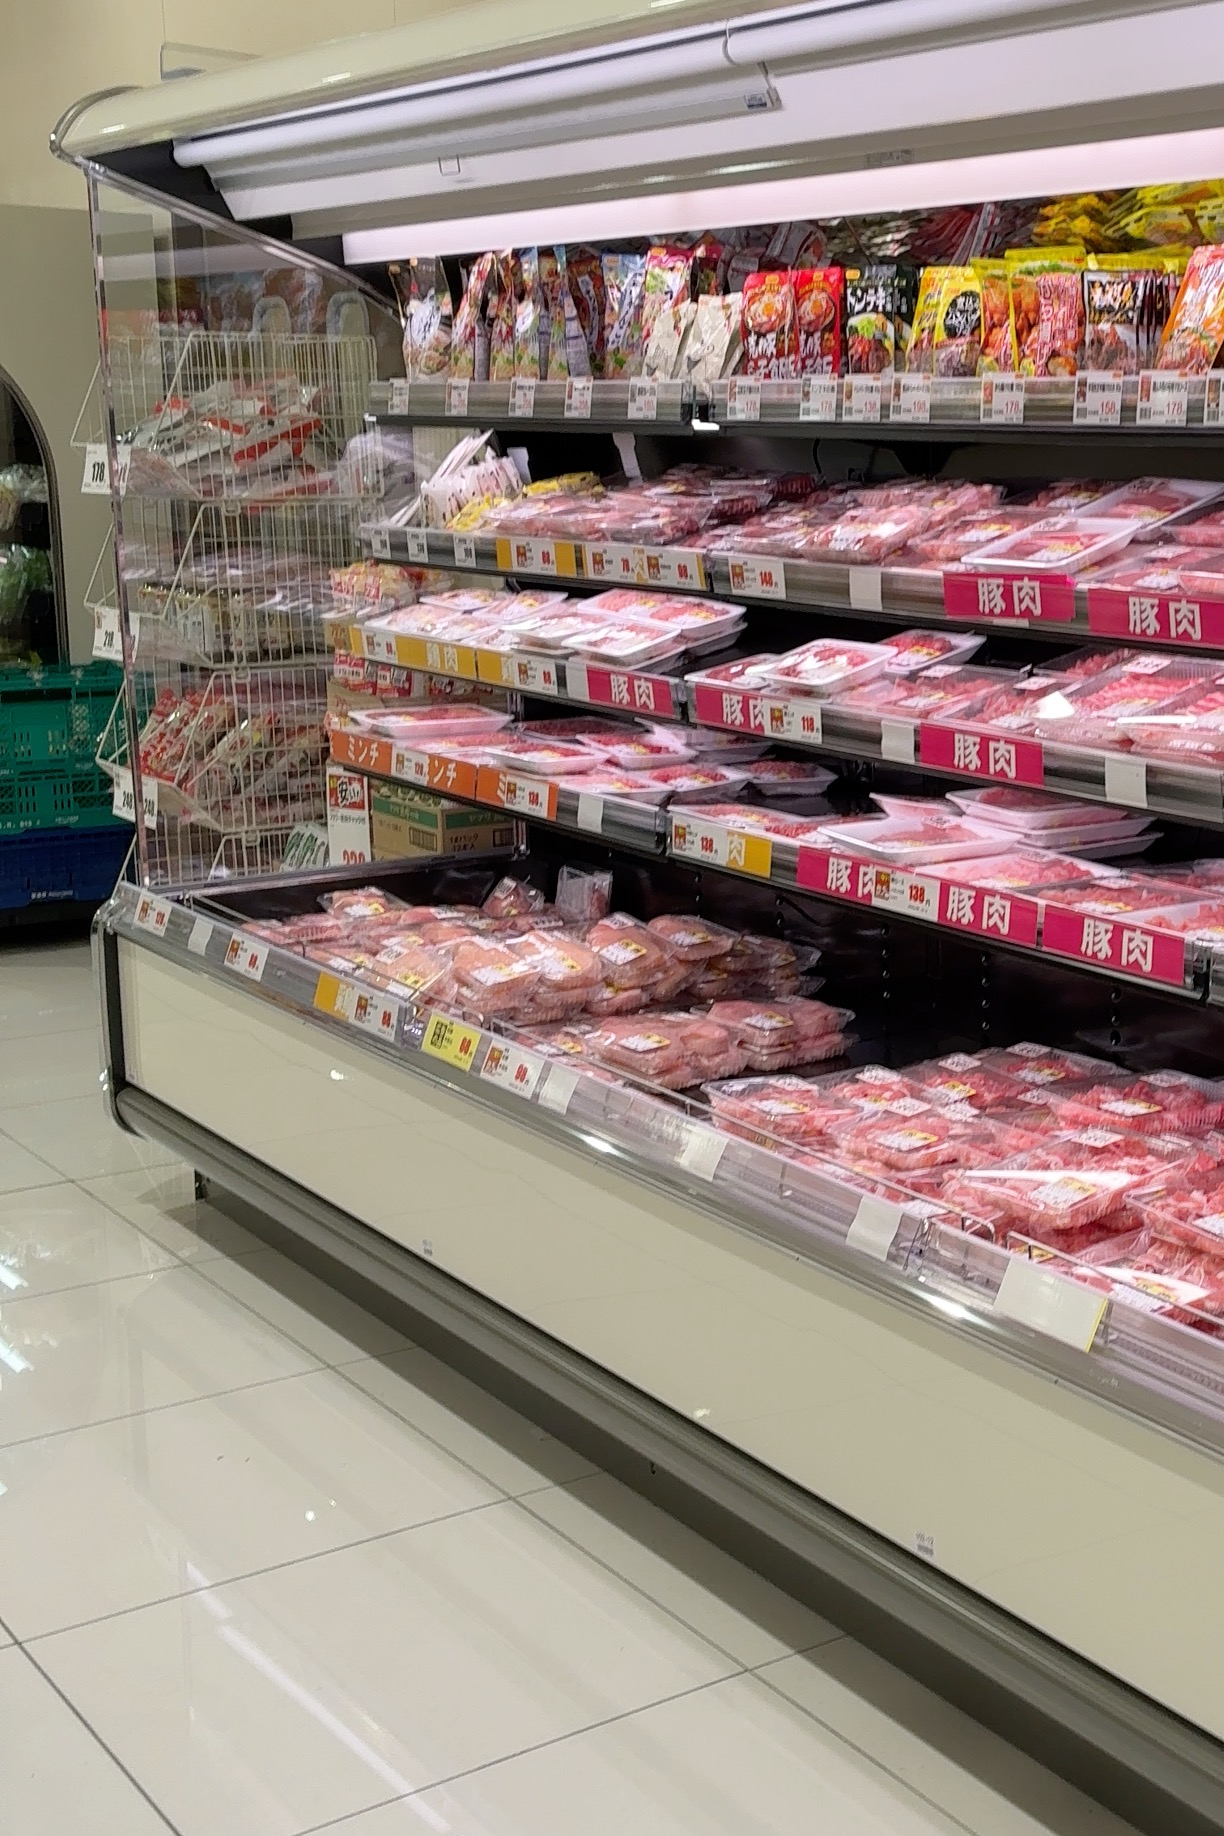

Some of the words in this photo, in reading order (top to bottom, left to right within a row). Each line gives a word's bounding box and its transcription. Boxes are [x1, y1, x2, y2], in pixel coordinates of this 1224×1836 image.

[978, 577, 1041, 617] 豚肉
[1128, 598, 1202, 641] 豚肉
[610, 673, 655, 711] 豚肉
[347, 737, 379, 767] ミンチ
[428, 758, 457, 787] ンチ
[953, 733, 1018, 779] 豚肉
[945, 885, 1012, 937] 豚肉
[1080, 917, 1154, 974] 豚肉
